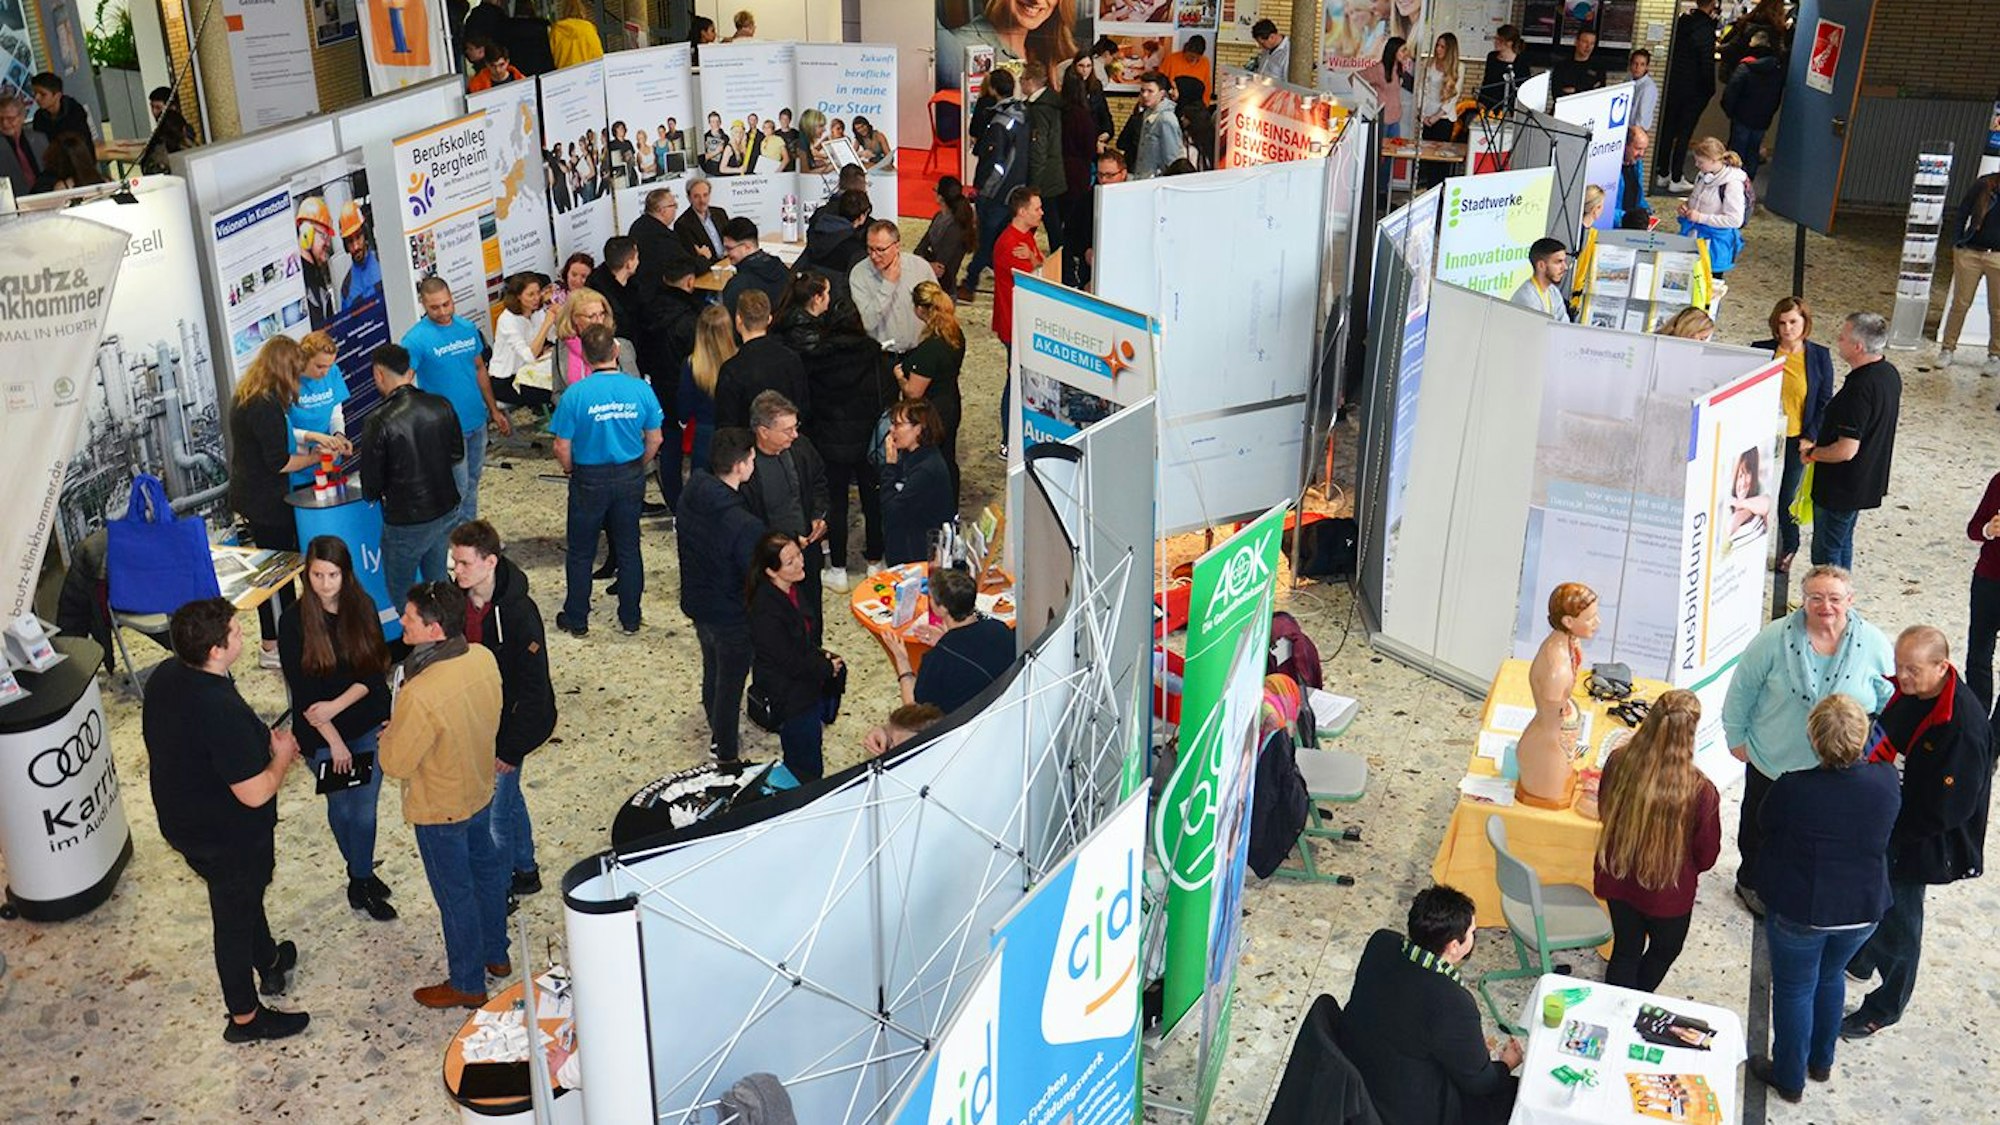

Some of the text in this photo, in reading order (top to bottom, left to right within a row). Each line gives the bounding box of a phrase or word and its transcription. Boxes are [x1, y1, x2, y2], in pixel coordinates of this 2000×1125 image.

[818, 101, 882, 115] Der Start
[852, 85, 887, 96] meine
[412, 128, 486, 165] Berufskolleg
[1234, 132, 1294, 163] BEWEGEN
[1235, 113, 1311, 151] GEMEINSAM
[431, 147, 488, 179] Bergheim
[1461, 193, 1523, 213] Stadtwerke
[1468, 271, 1514, 293] Hürth!
[1034, 317, 1105, 353] RHEIN-ERFT
[1035, 338, 1103, 373] AKADEMIE
[1024, 419, 1063, 444] Aus
[11, 460, 64, 618] bautz-klinkhammer.de
[1205, 528, 1274, 620] AOK
[1682, 511, 1707, 670] Ausbildung
[49, 832, 80, 853] im
[84, 806, 110, 840] Audi
